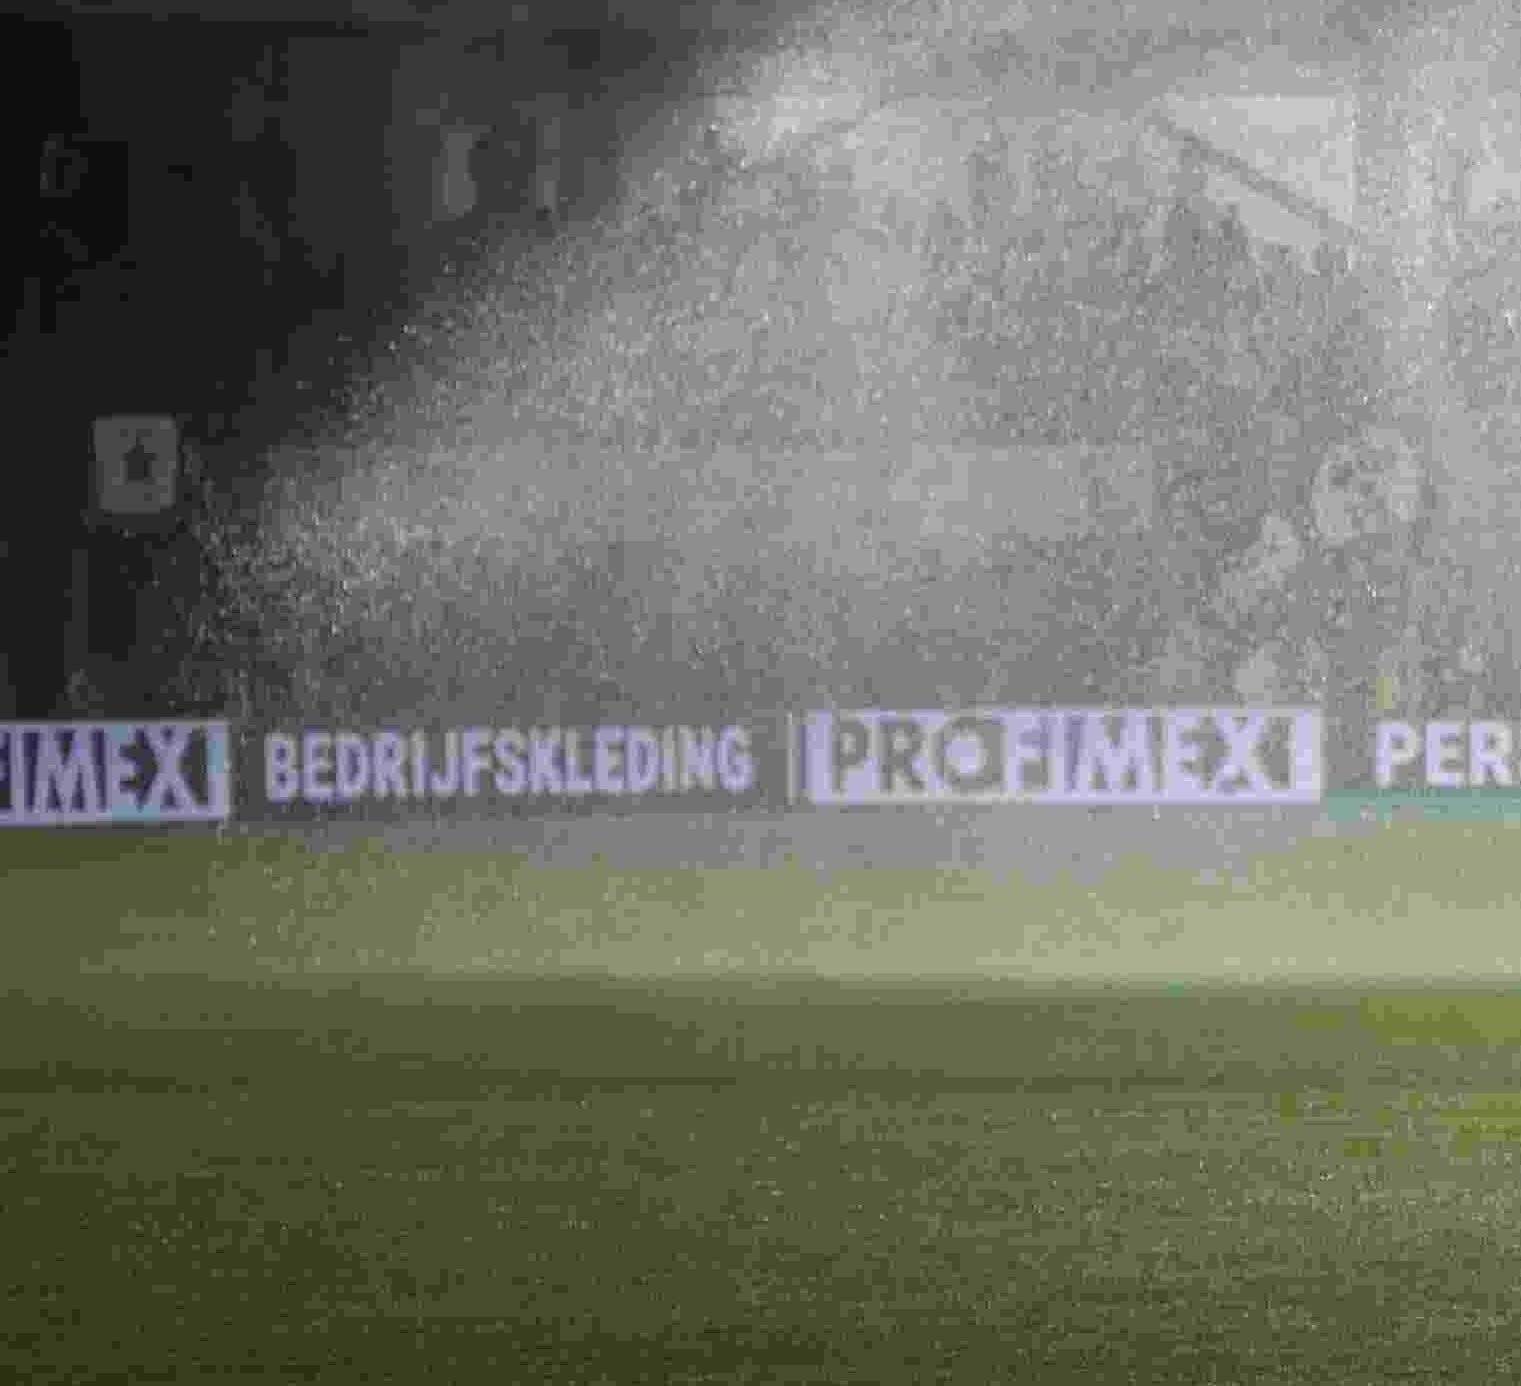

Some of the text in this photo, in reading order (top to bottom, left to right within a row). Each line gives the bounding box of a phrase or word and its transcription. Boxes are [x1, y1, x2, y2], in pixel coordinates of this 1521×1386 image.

[0, 727, 196, 813] IMEX
[265, 725, 754, 802] BEDRIJFSKLEDING
[832, 713, 1278, 797] PROFIMEX
